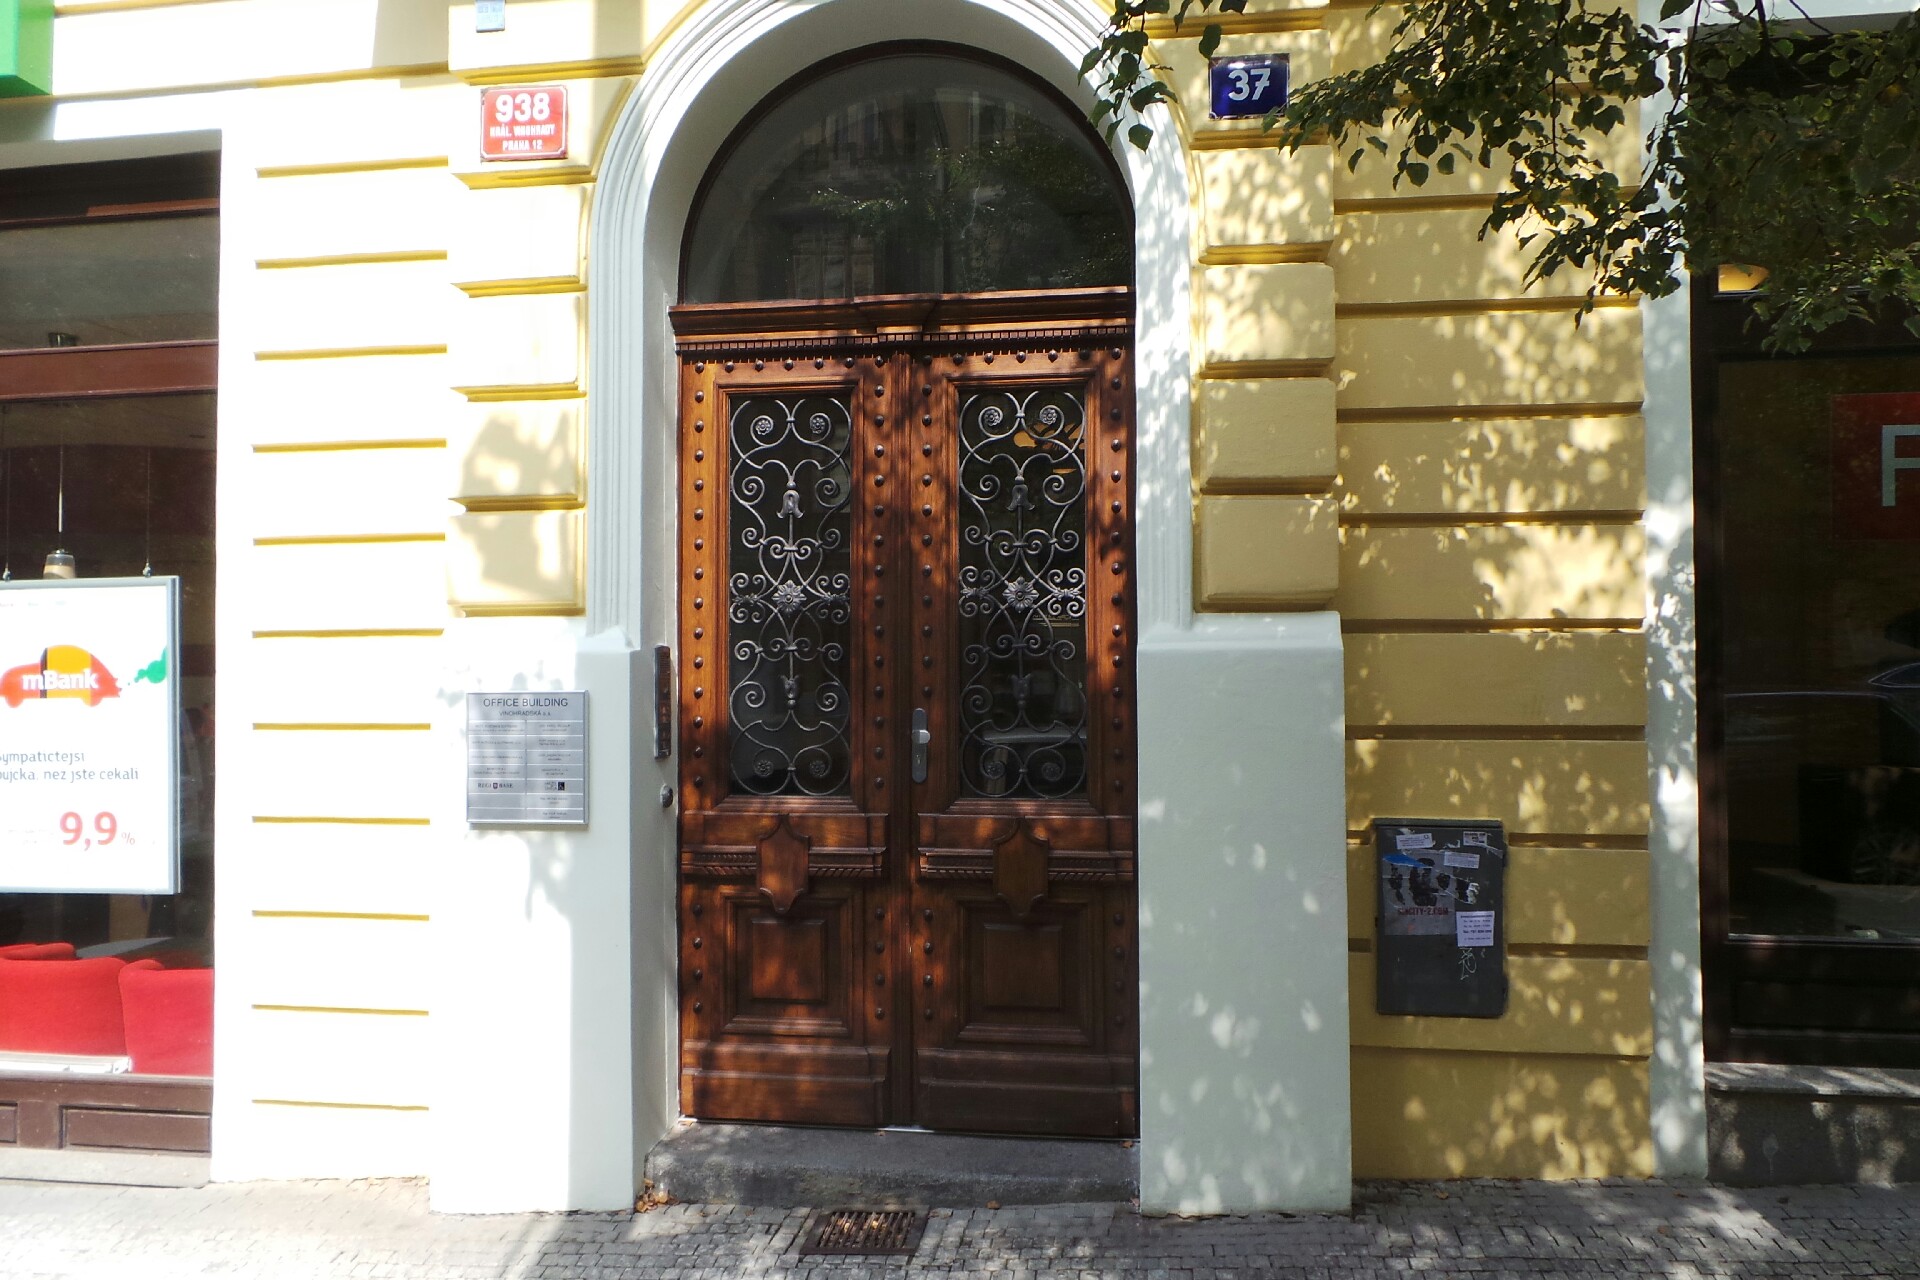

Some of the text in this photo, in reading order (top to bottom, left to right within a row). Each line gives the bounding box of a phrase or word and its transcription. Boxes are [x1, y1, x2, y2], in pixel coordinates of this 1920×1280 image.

[1228, 68, 1270, 100] 37
[495, 92, 550, 122] 938
[502, 140, 529, 151] PRAHA
[22, 669, 98, 690] mBank
[483, 698, 568, 707] OFFICE BUILDING
